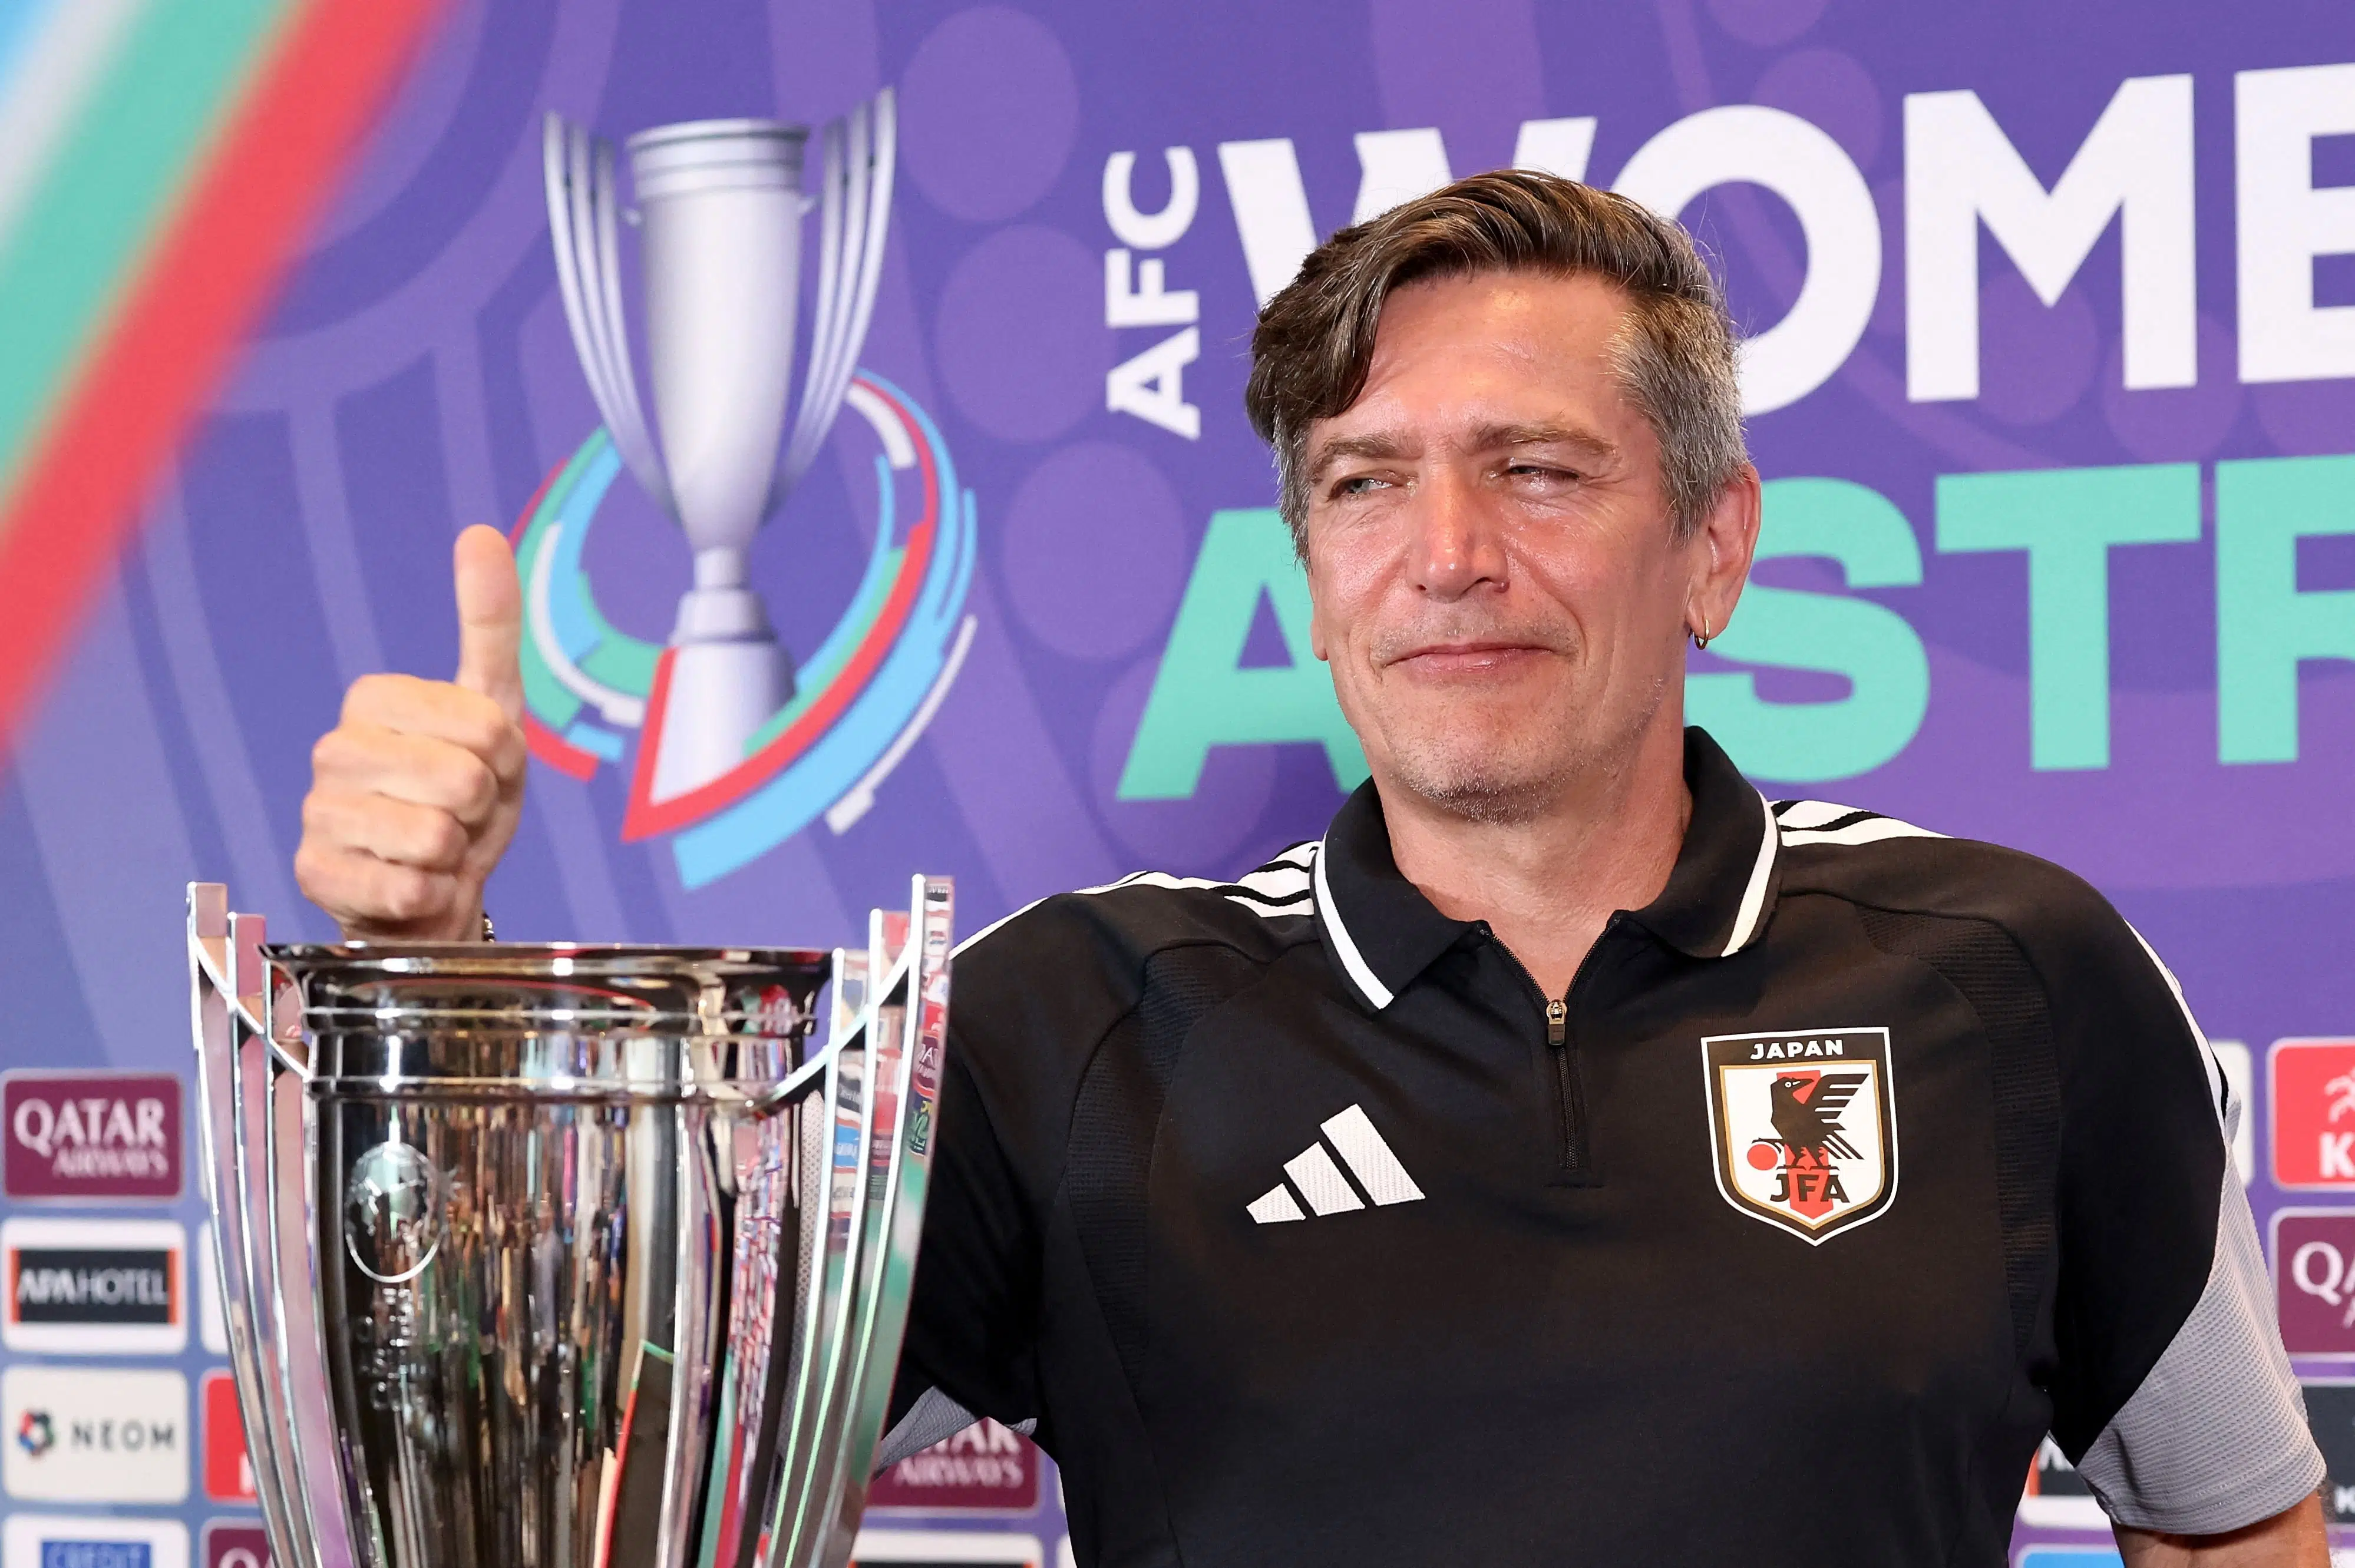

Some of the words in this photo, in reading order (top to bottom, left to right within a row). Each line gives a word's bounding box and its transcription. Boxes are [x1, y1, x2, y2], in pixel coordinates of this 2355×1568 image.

[1102, 145, 1200, 441] AFC
[1750, 1039, 1843, 1060] JAPAN
[13, 1097, 167, 1158] QATAR
[1770, 1173, 1850, 1203] JFA
[71, 1420, 176, 1451] NEOM
